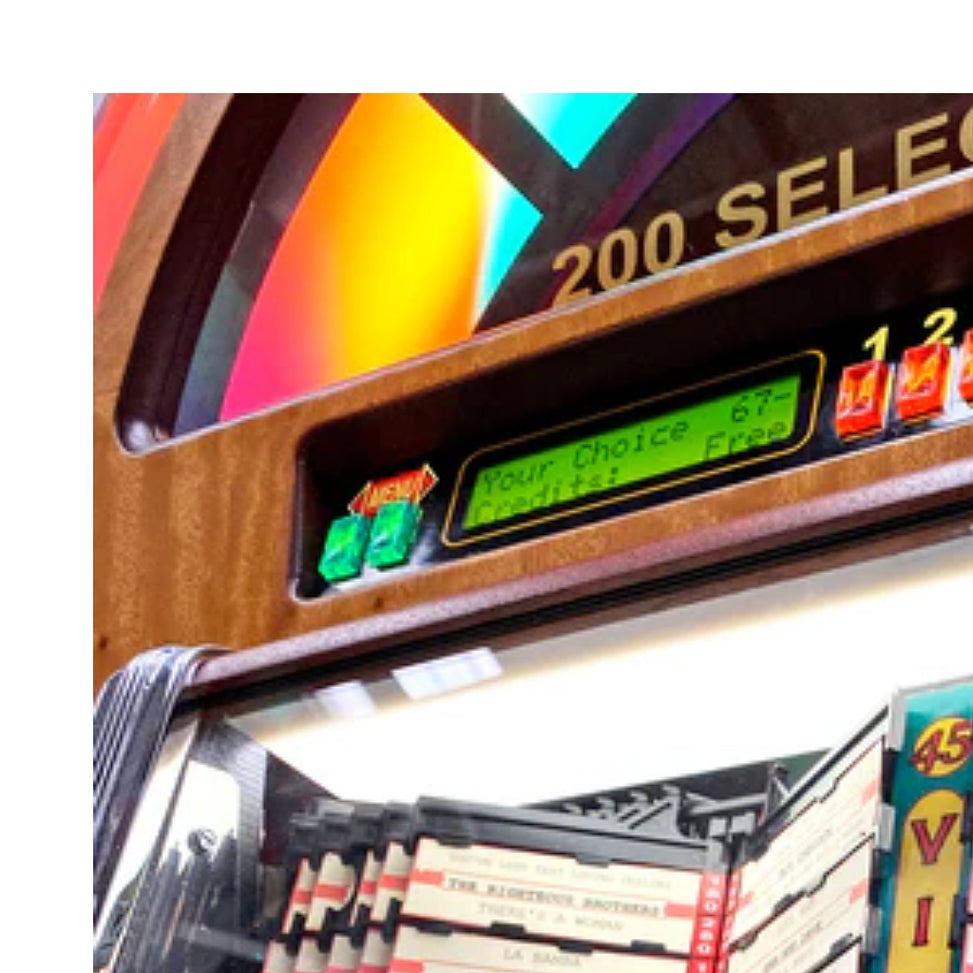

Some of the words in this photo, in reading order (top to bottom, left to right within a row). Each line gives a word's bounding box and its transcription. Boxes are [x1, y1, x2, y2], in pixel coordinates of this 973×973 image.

[552, 210, 686, 308] 200
[863, 323, 889, 361] 1
[922, 307, 958, 345] 2
[483, 461, 554, 496] Your
[572, 421, 690, 470] Choice
[704, 420, 787, 460] Free
